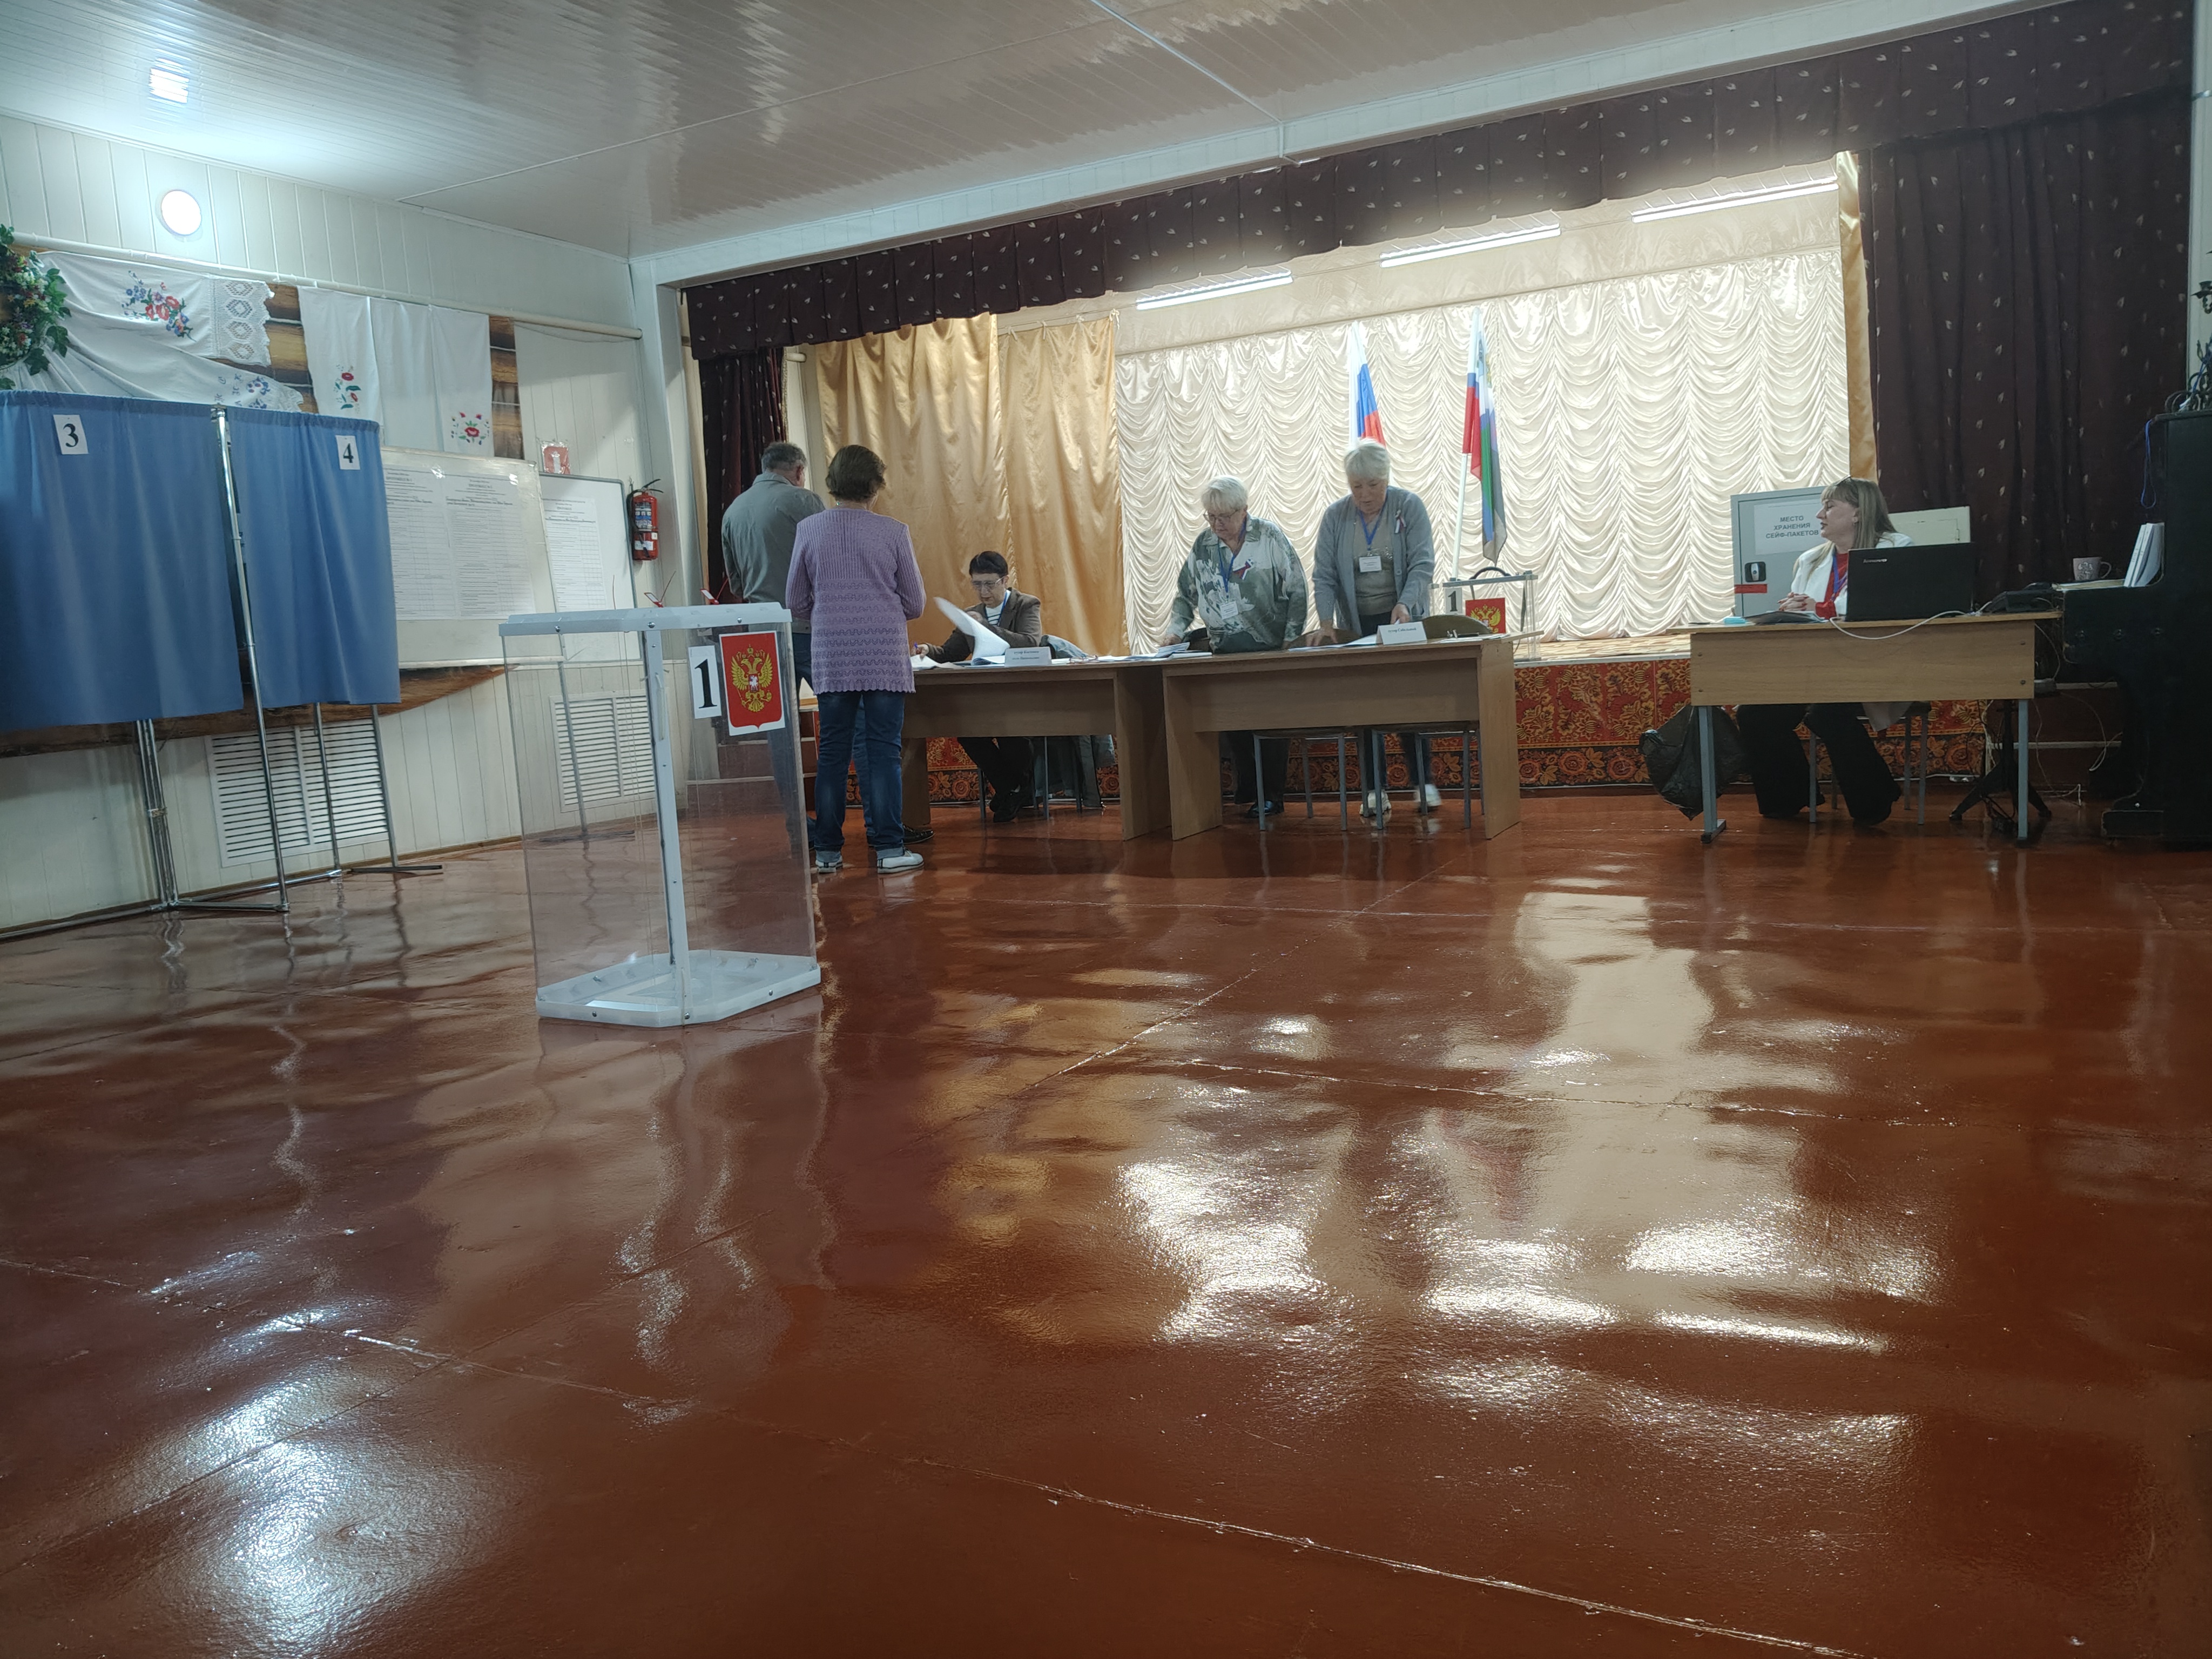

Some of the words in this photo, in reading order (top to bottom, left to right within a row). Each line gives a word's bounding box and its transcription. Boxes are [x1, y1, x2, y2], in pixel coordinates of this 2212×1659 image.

[63, 423, 79, 447] 3
[343, 443, 354, 463] 4
[1765, 530, 1819, 539] СЕЙФ-ПАКЕТОВ
[1448, 591, 1458, 612] 1
[694, 659, 718, 709] 1
